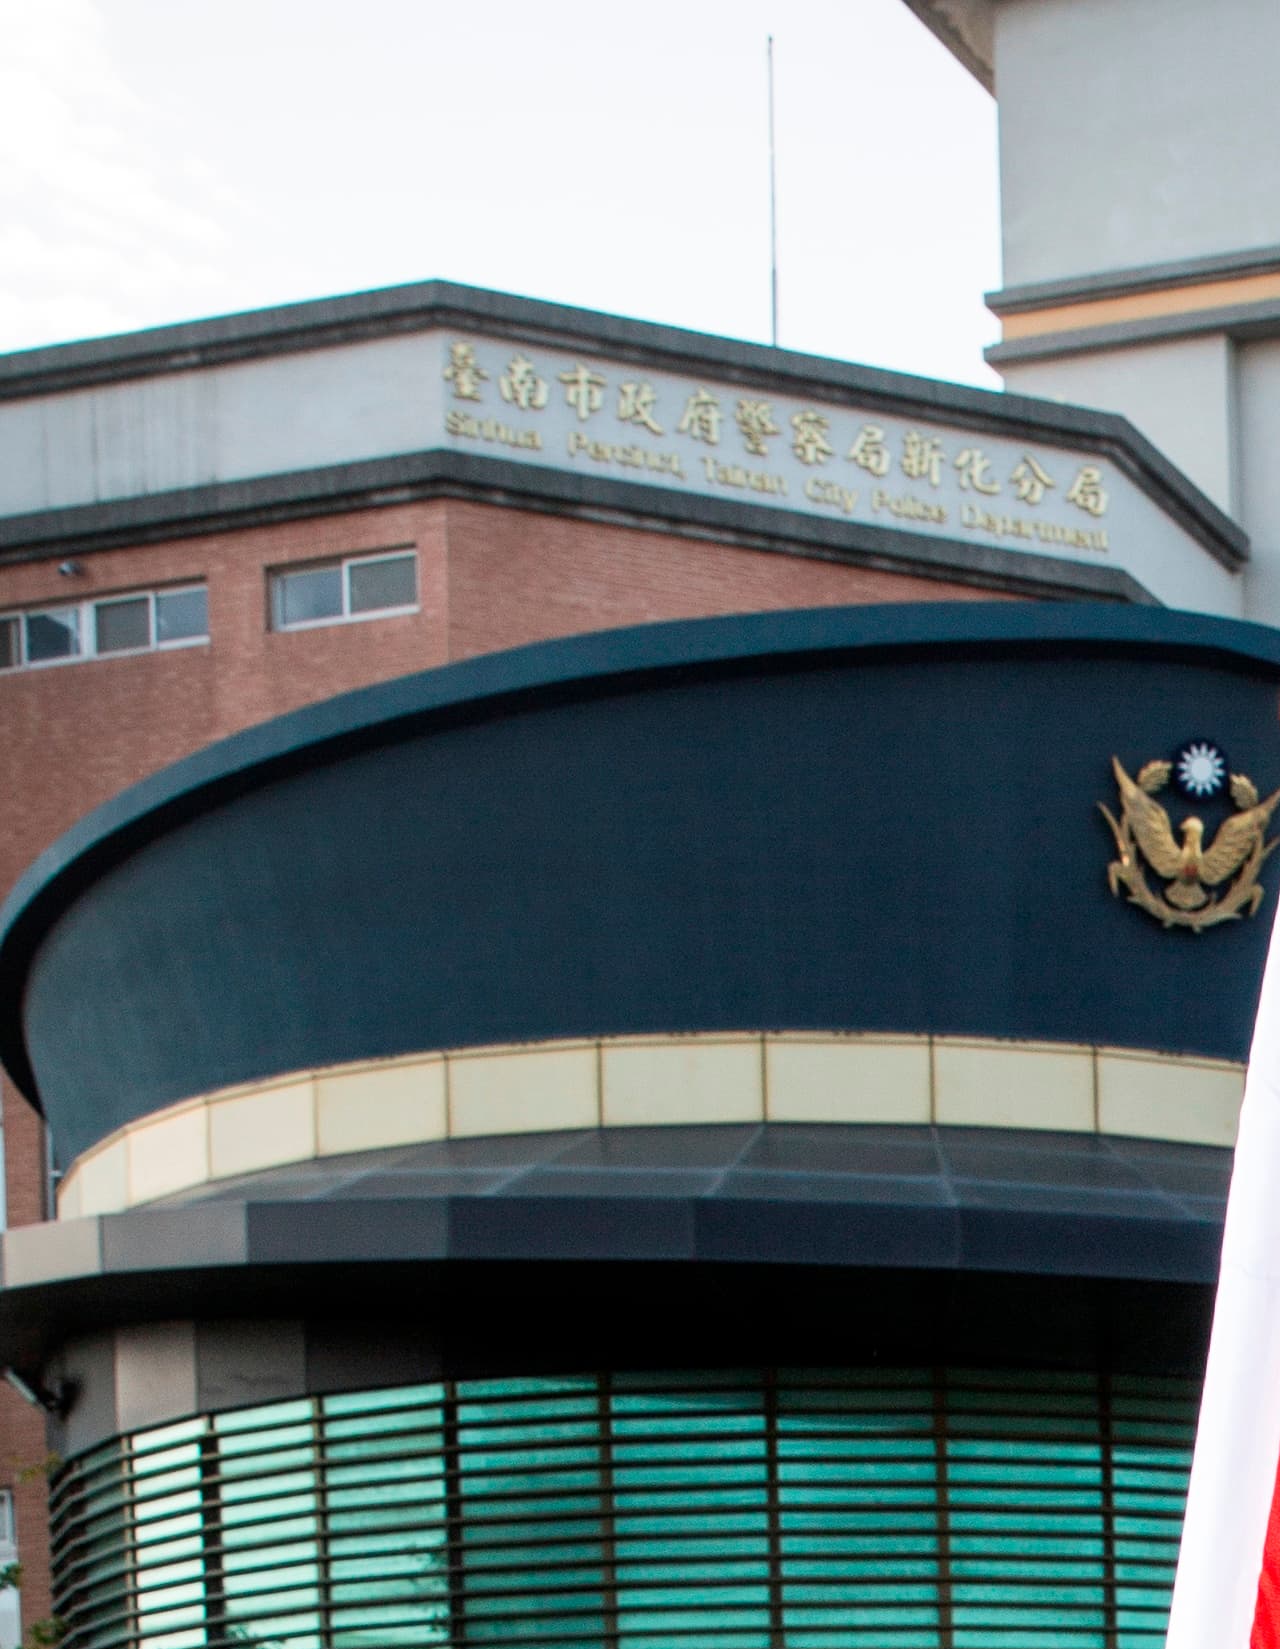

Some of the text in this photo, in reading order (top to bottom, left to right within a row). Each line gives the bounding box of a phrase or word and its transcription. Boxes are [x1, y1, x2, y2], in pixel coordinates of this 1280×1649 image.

[443, 341, 1109, 517] 臺南市政府警察局新化分局
[446, 410, 543, 451] Sinhua
[701, 455, 789, 497] Tainan
[803, 475, 859, 514] City
[870, 489, 946, 524] Police
[960, 503, 1110, 552] Department
